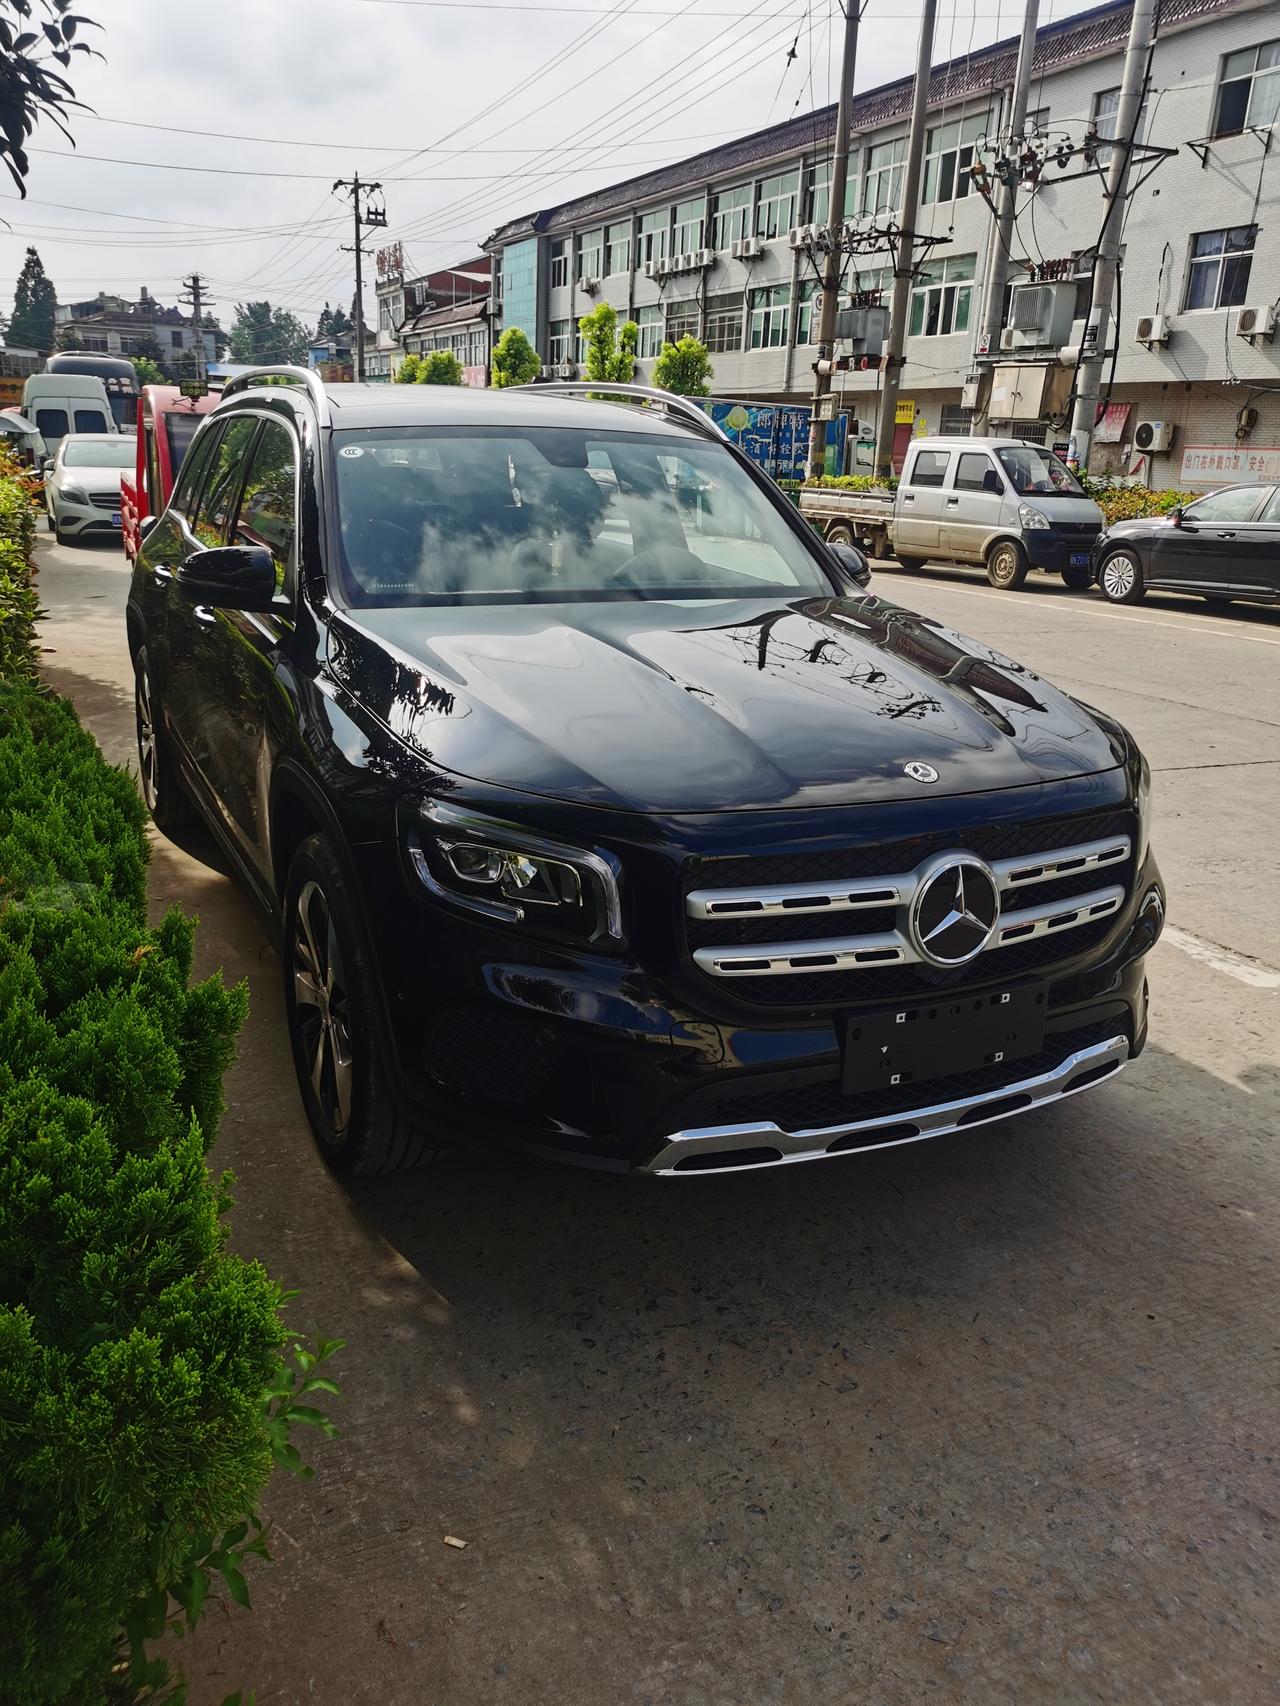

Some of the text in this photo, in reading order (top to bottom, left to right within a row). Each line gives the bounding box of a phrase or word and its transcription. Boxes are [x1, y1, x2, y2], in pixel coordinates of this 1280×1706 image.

[757, 412, 809, 430] 郎牌特
[344, 448, 358, 456] CCC
[1184, 454, 1280, 472] 出门在外戴口罩，安全
